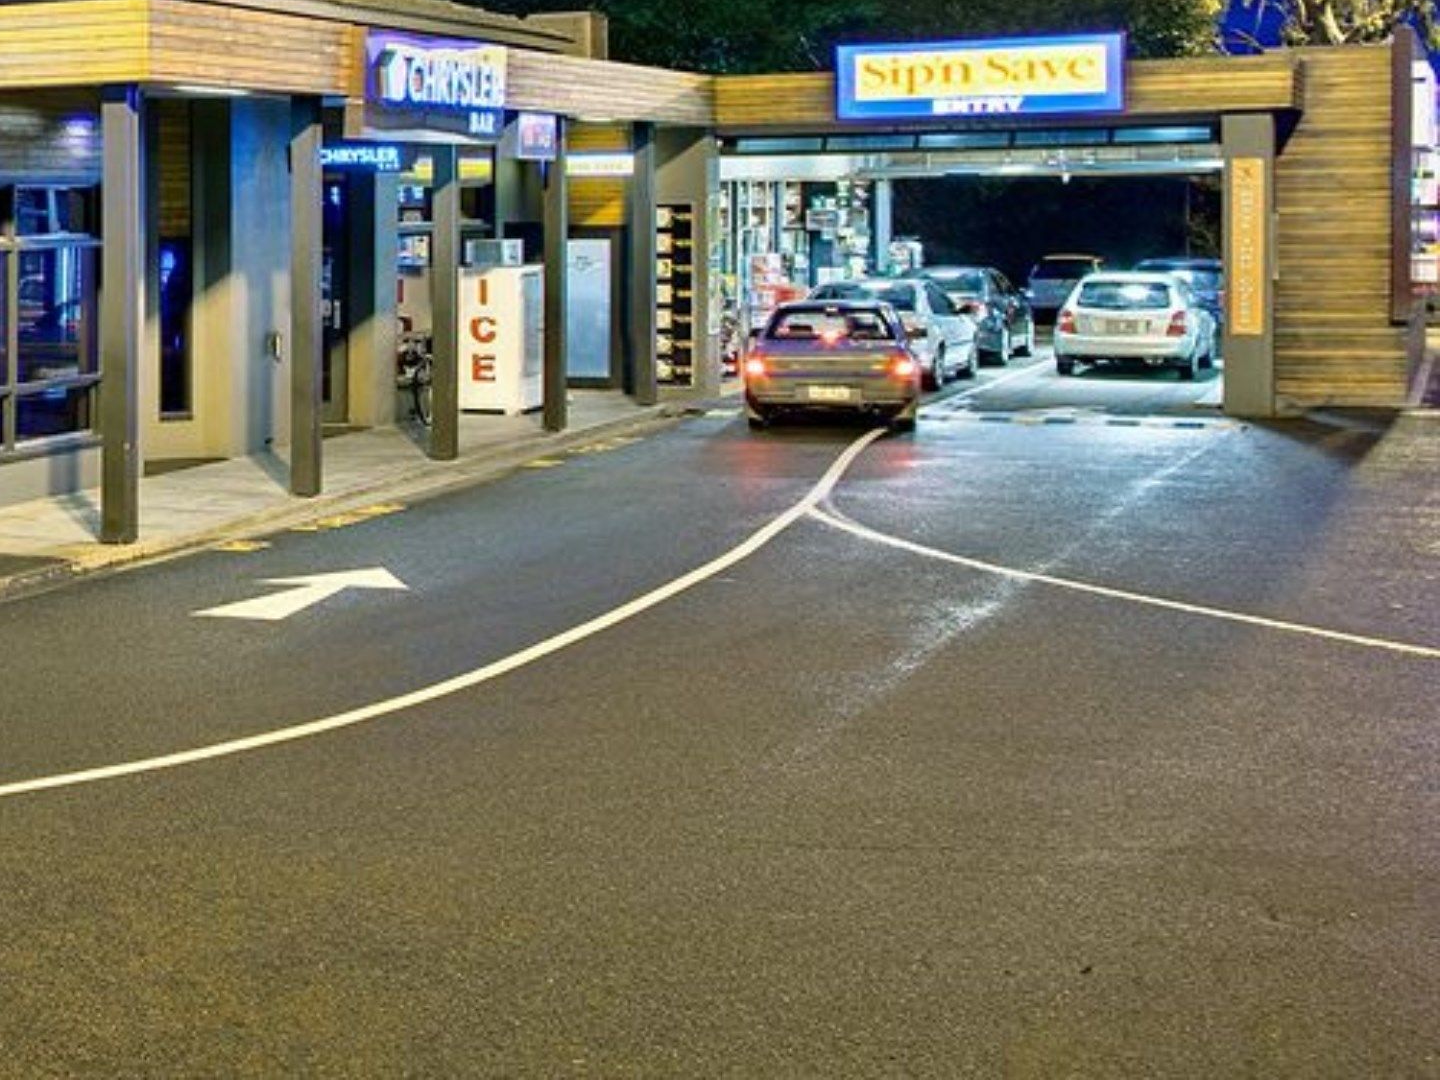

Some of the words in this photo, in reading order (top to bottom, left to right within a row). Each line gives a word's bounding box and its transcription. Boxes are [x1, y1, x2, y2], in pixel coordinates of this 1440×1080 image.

[409, 53, 506, 108] CHRYSLER
[987, 53, 1095, 84] Save
[468, 111, 495, 134] BAR
[470, 278, 497, 382] ICE
